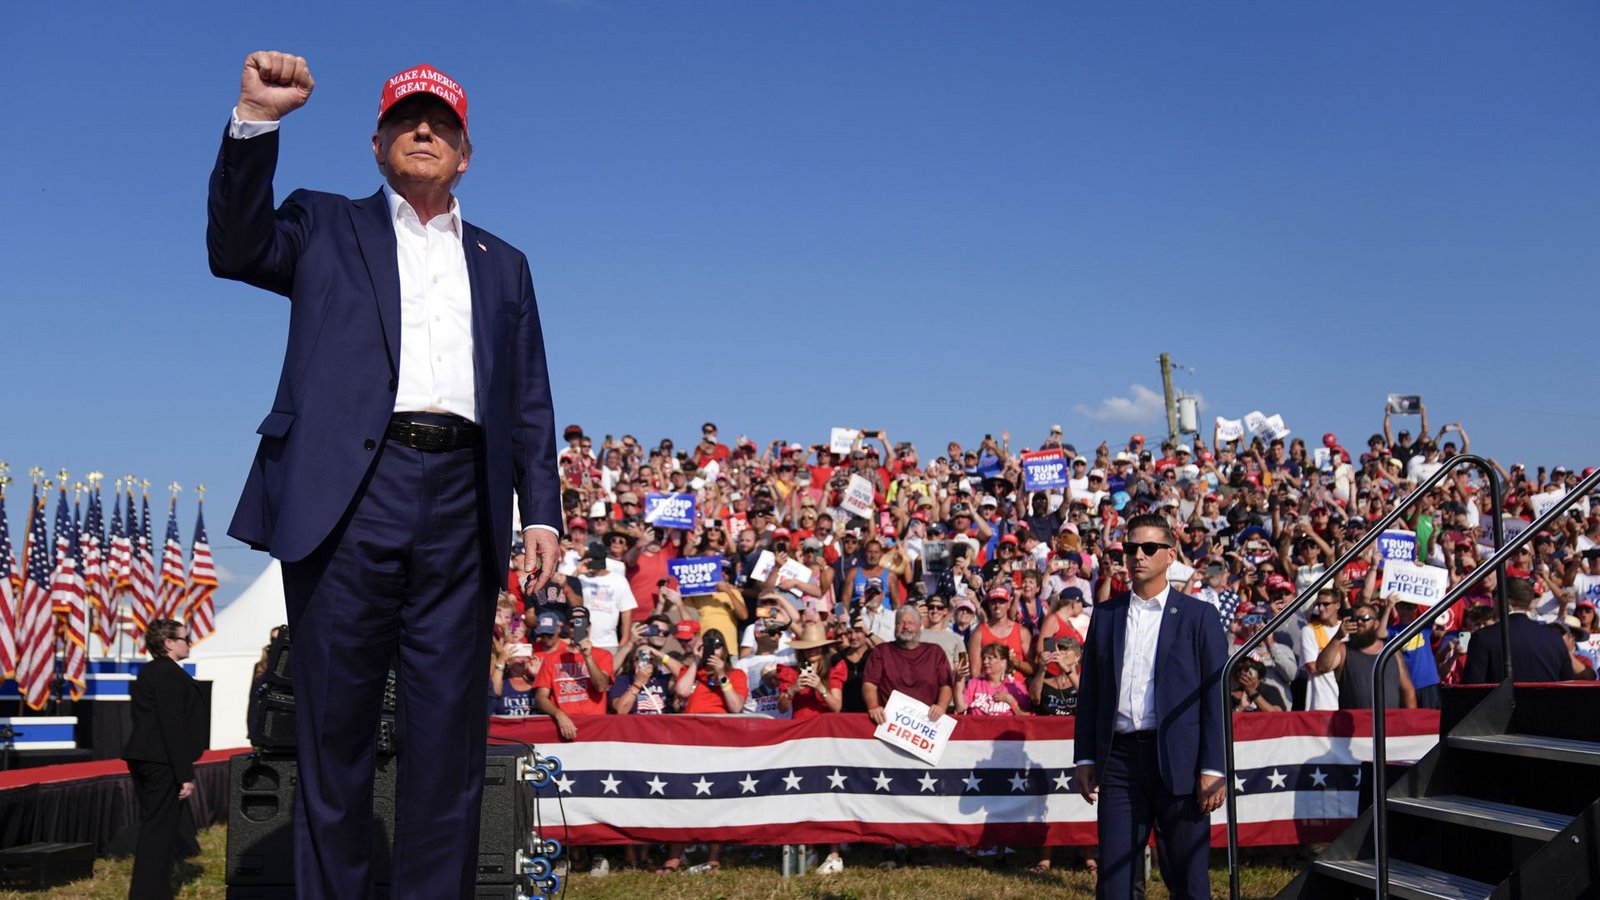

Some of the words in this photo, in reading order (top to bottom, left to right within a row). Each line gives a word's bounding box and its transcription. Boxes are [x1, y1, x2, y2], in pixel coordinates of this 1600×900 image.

[389, 70, 418, 88] MAKE
[419, 69, 464, 98] AMERICA
[395, 82, 428, 98] GREAT
[429, 84, 458, 106] AGAIN
[1027, 463, 1064, 475] TRUMP
[1033, 472, 1060, 482] 2024
[650, 498, 692, 510] TRUMP
[1381, 538, 1415, 550] TRUMP
[1387, 547, 1413, 559] 2024
[671, 562, 717, 575] TRUMP
[679, 572, 712, 584] 2024
[1394, 573, 1437, 586] YOU'RE
[536, 586, 566, 605] USA
[1387, 581, 1440, 599] FIRED!
[755, 696, 780, 705] TRUM
[760, 703, 777, 712] 202
[895, 712, 937, 740] YOU'RE
[887, 723, 935, 753] FIRED!
